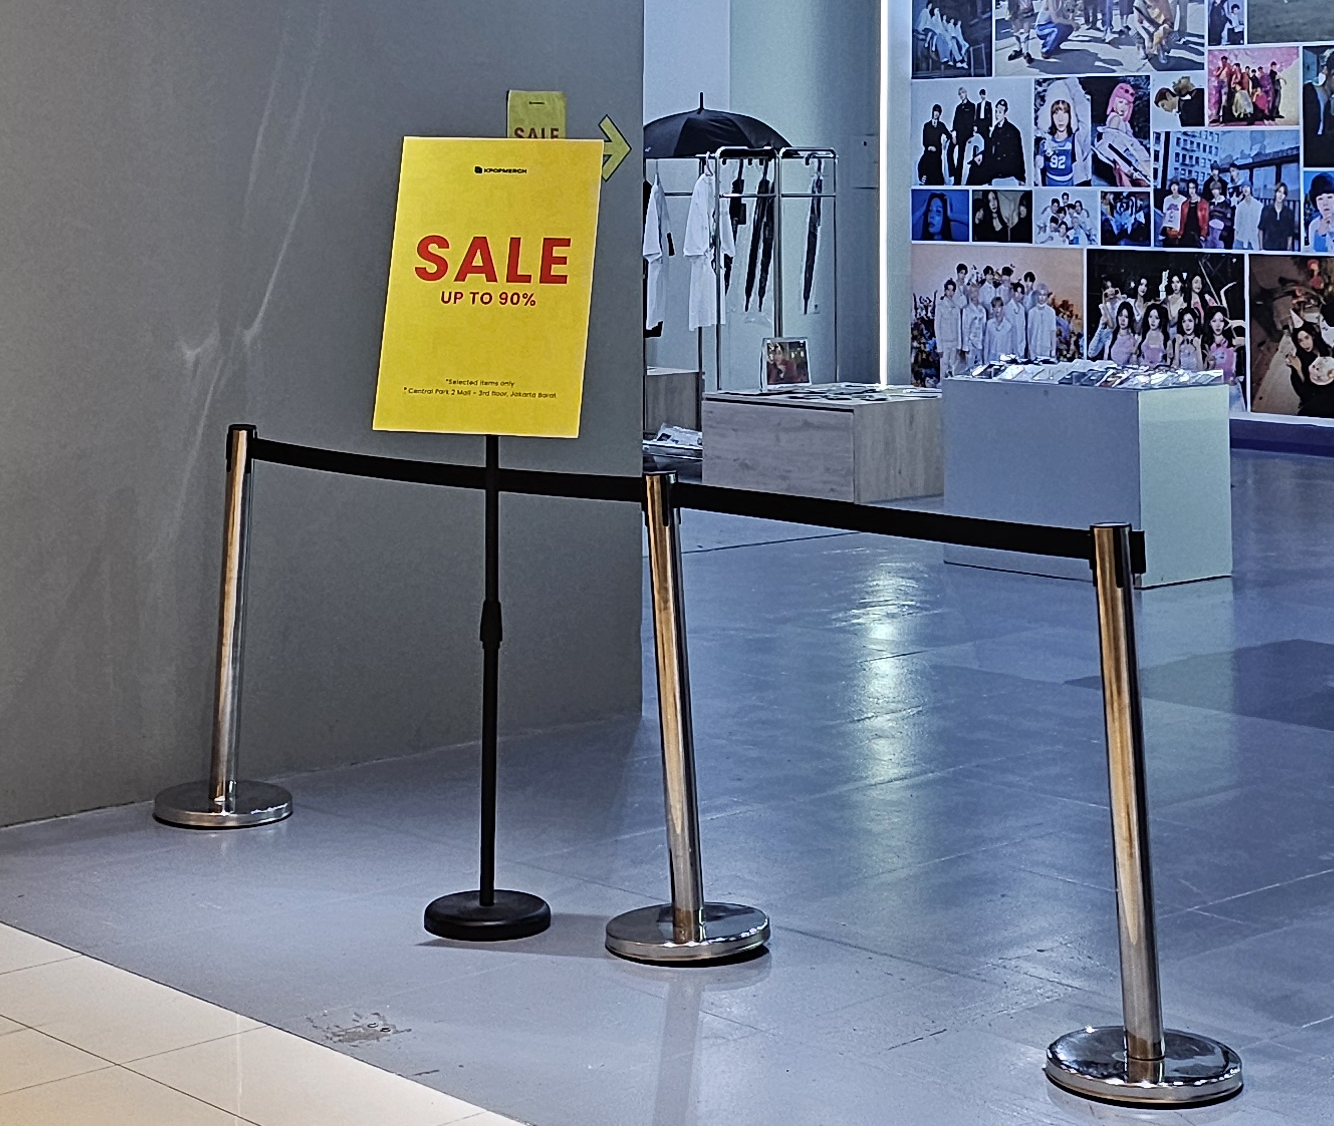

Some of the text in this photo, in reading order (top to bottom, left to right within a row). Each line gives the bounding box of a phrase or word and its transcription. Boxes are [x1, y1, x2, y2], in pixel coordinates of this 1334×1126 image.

[1050, 155, 1066, 169] 92
[415, 235, 571, 284] SALE
[440, 291, 537, 307] UP TO 90%
